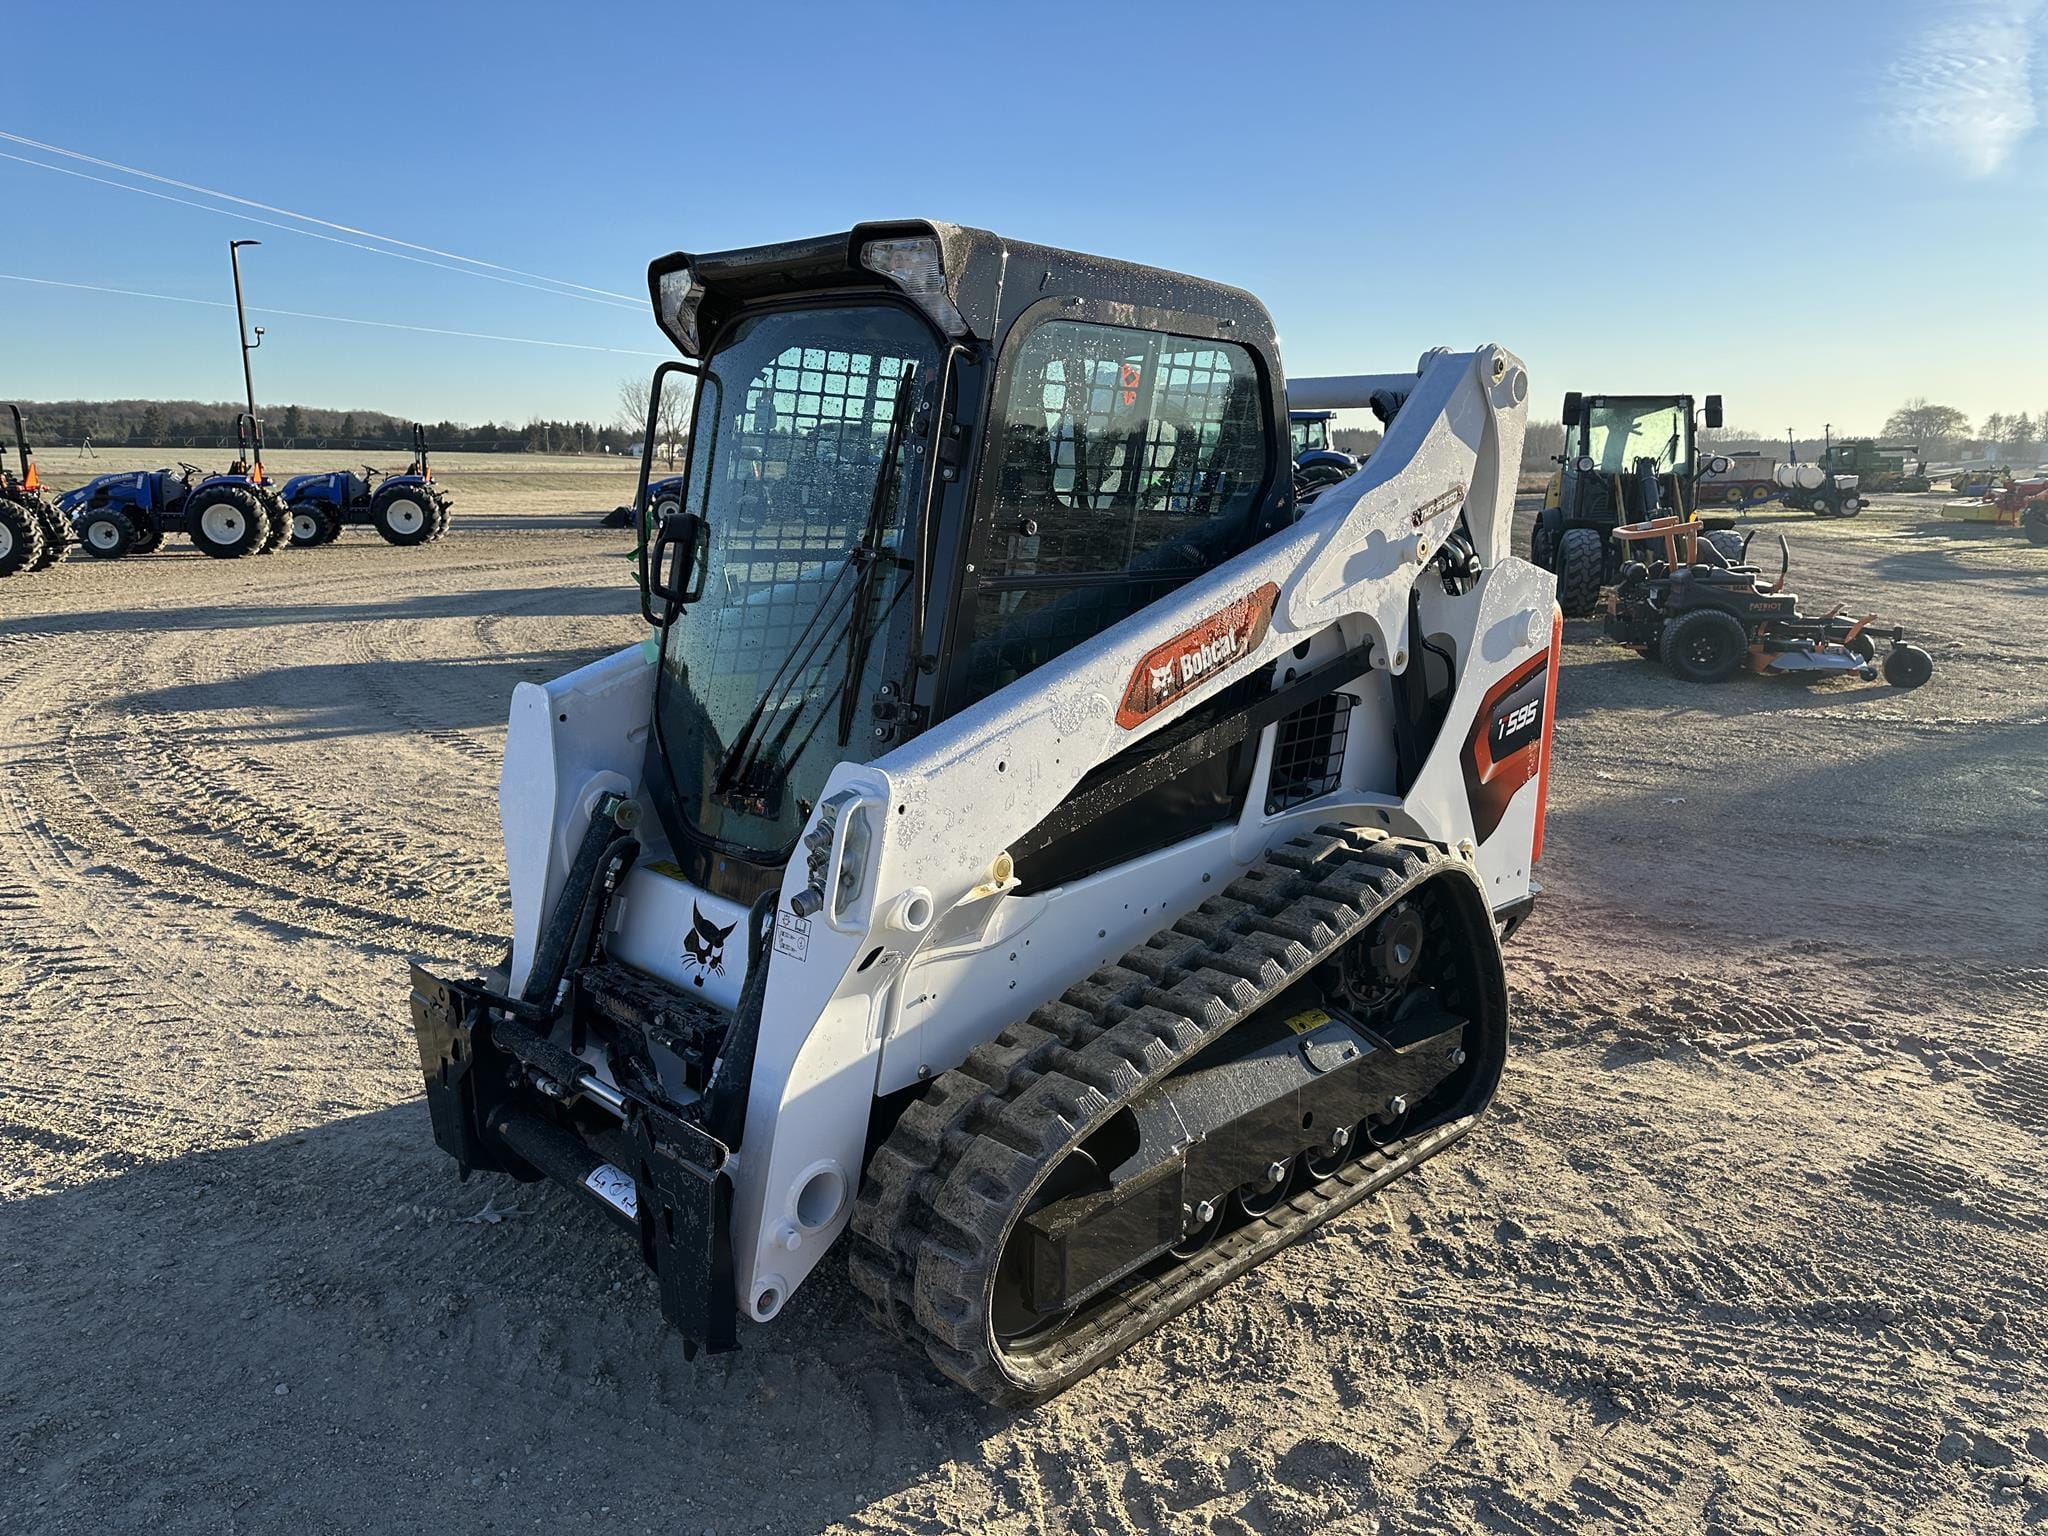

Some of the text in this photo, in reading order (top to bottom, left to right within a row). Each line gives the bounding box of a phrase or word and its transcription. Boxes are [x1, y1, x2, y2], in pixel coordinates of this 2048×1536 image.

[1749, 602, 1782, 611] PATRIOT
[1180, 627, 1237, 683] Bobcat
[1498, 699, 1539, 740] T595
